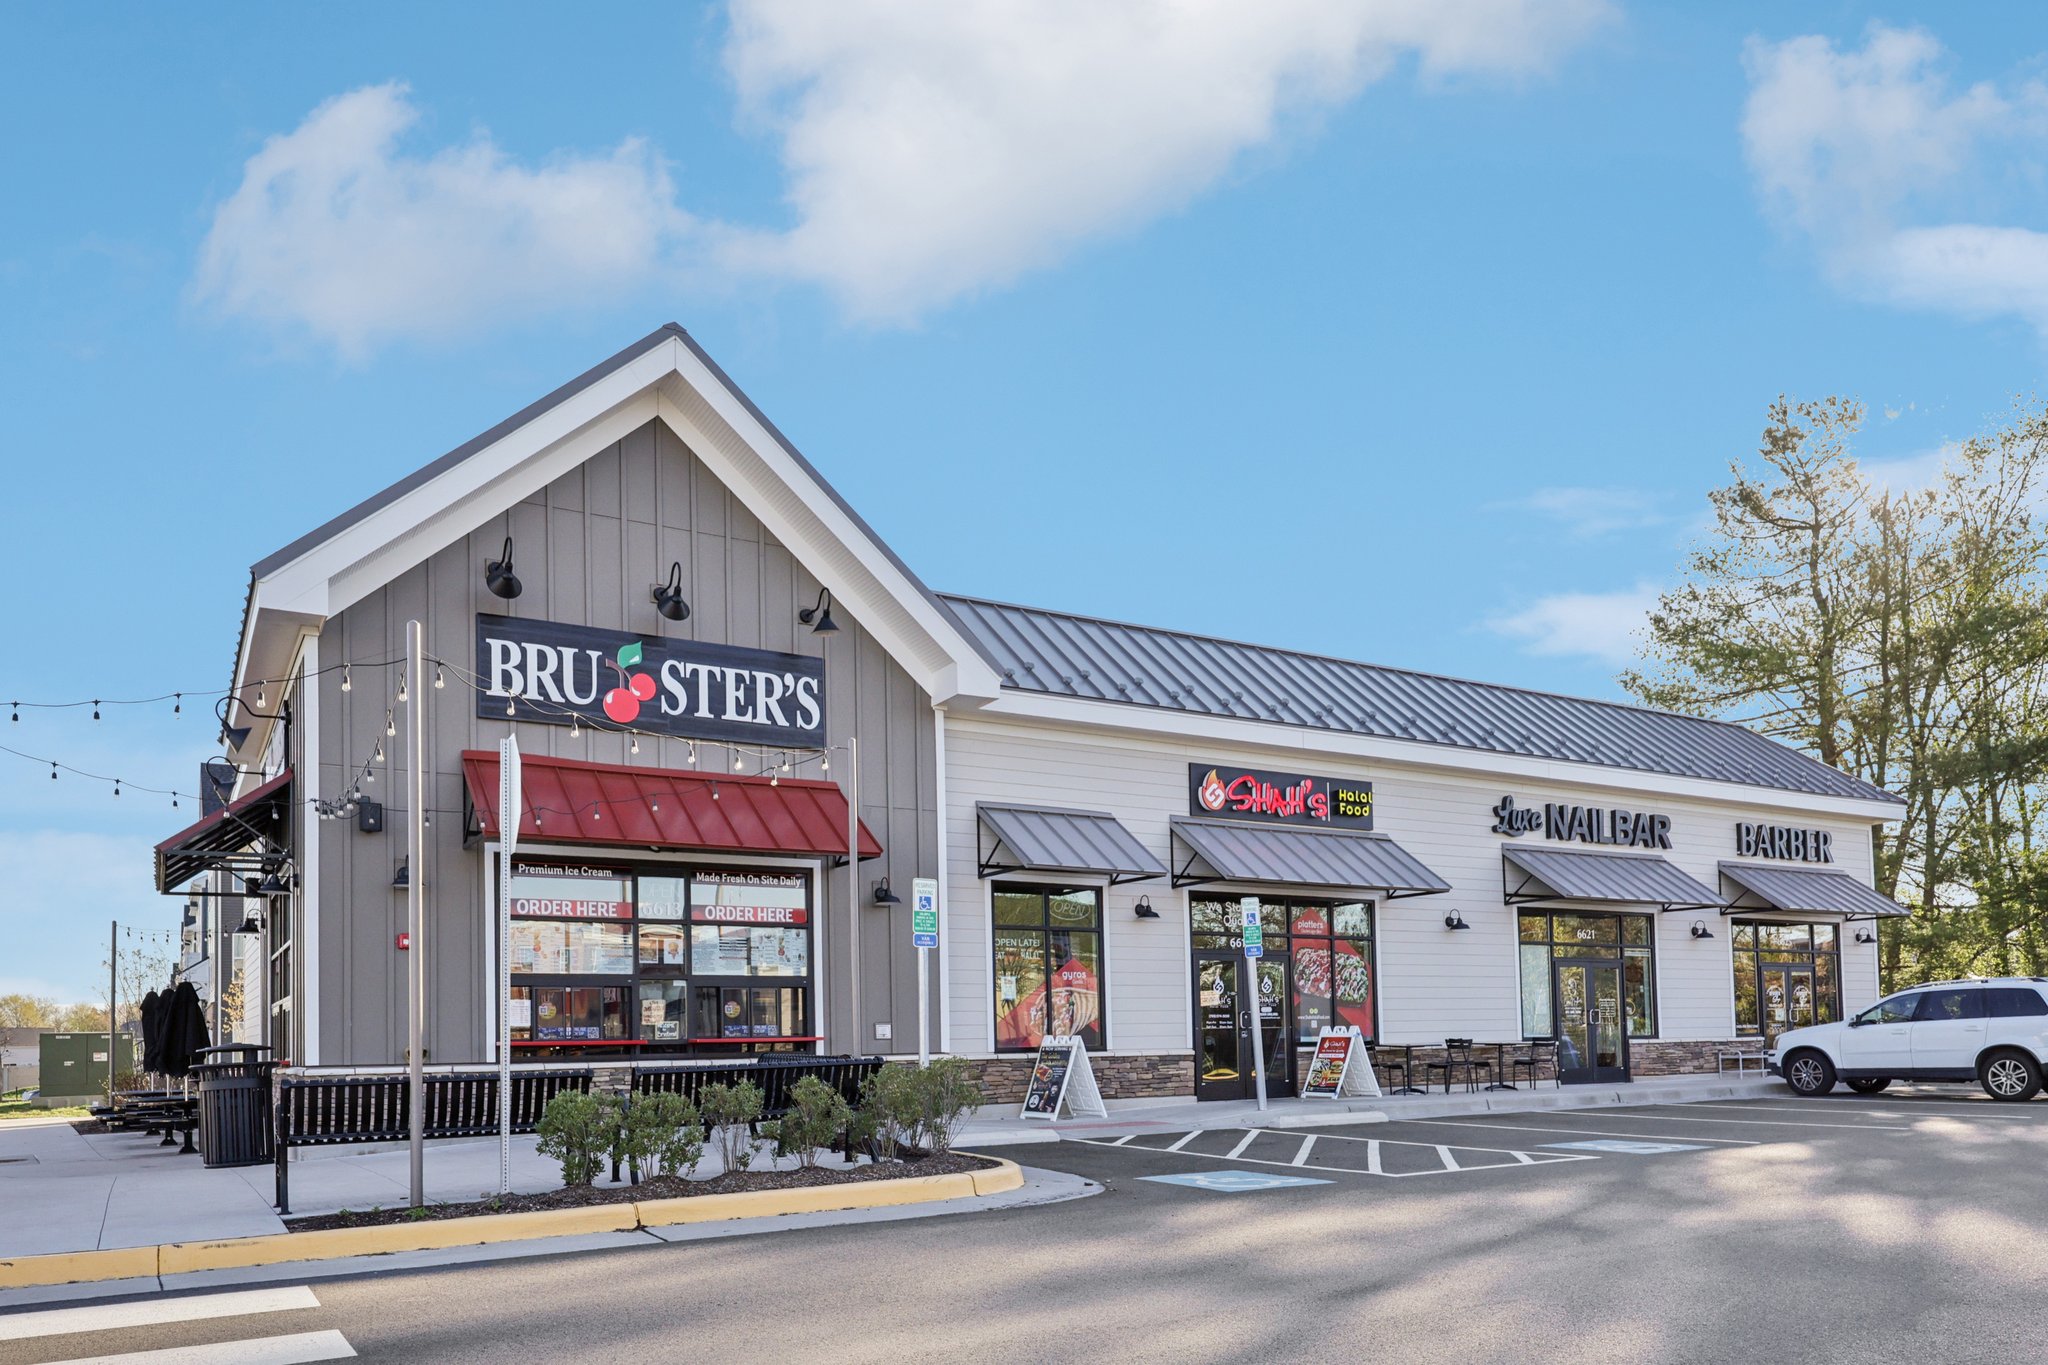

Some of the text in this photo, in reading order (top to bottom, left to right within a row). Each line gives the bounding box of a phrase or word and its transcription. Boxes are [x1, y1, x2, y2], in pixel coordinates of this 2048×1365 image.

[485, 638, 821, 730] BRU STER'S
[1339, 788, 1373, 804] Halal
[1339, 803, 1370, 817] Food
[1492, 795, 1543, 837] Luxe
[1736, 822, 1835, 863] BARBER
[518, 864, 613, 877] Premium Ice Cream
[696, 872, 801, 889] Made Fresh On Site Daily
[516, 899, 618, 917] ORDER HERE
[641, 902, 682, 916] 6613
[704, 905, 794, 922] ORDER HERE
[1053, 901, 1086, 917] OPEN
[1206, 900, 1223, 912] We
[1225, 901, 1242, 912] Sto
[1297, 920, 1324, 930] platters
[995, 938, 1017, 946] OPEN
[1577, 929, 1596, 940] 6621
[1061, 971, 1087, 981] gyros
